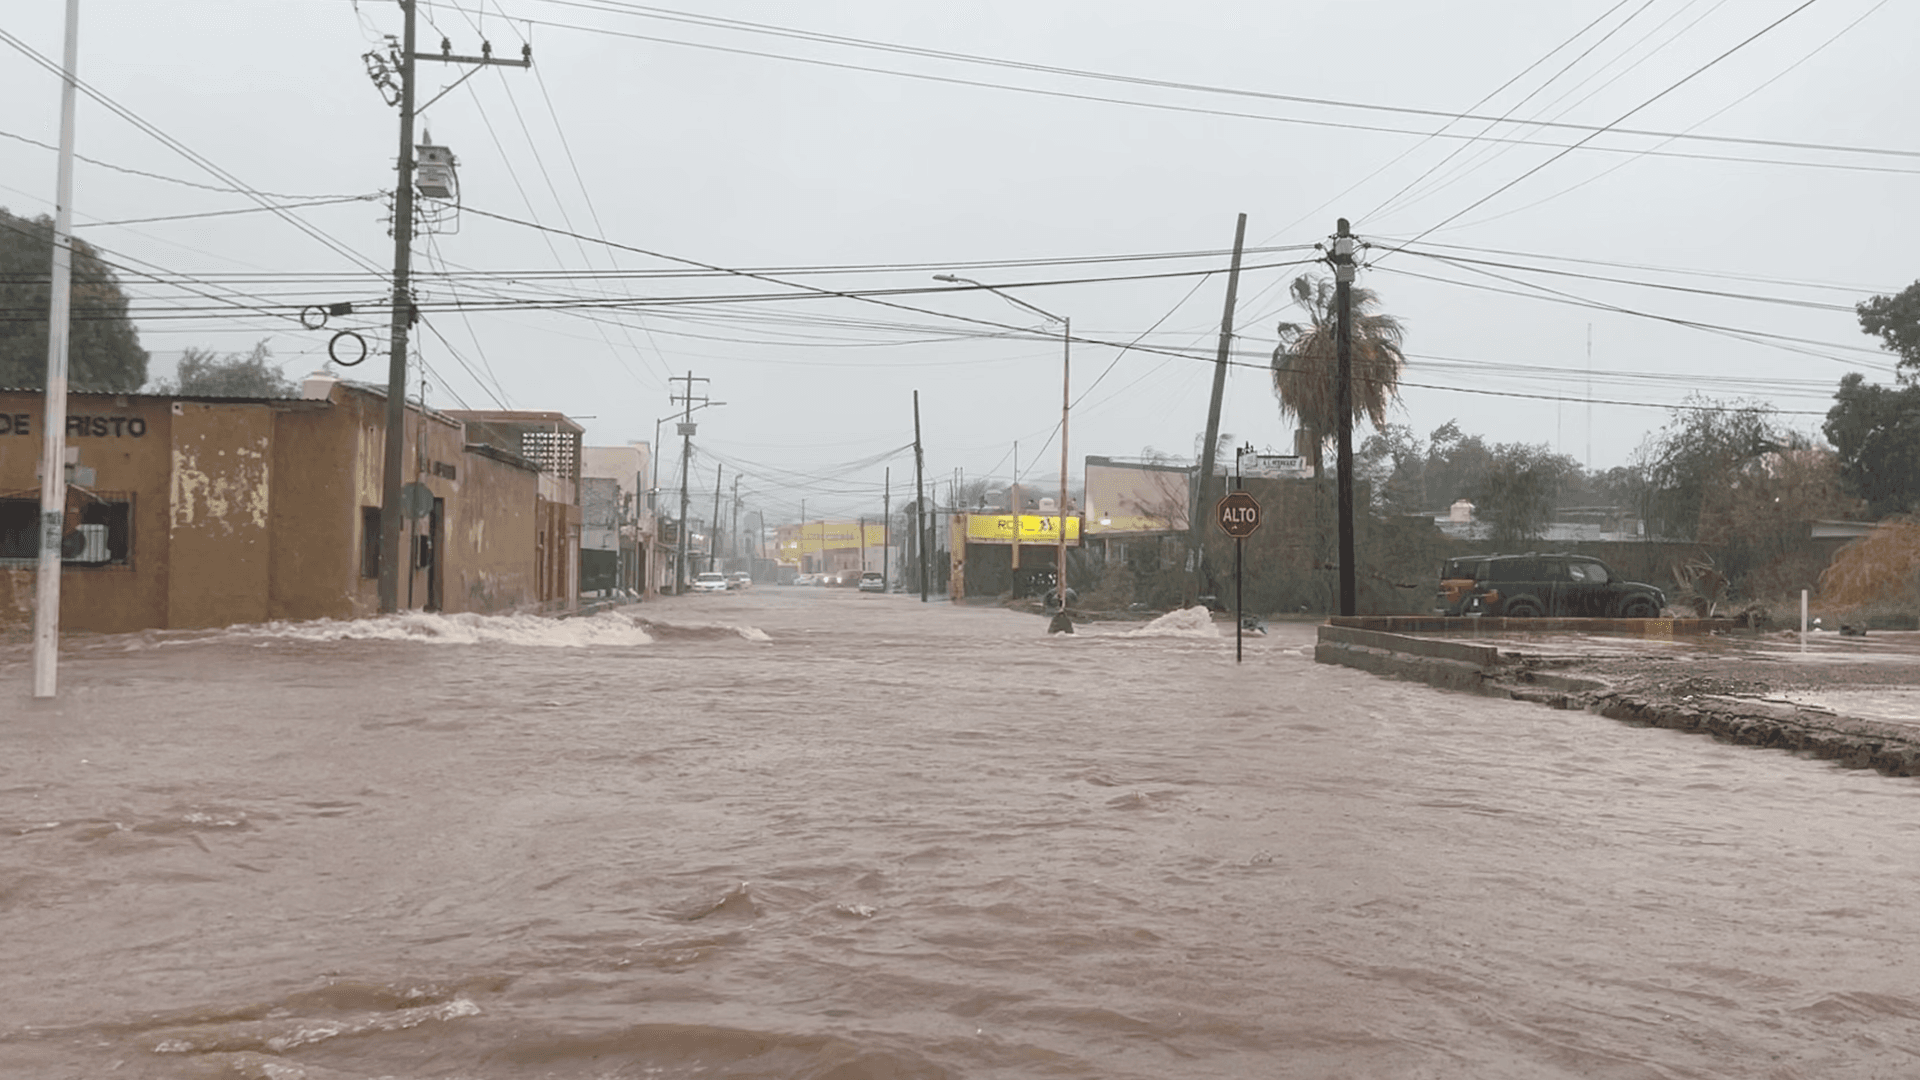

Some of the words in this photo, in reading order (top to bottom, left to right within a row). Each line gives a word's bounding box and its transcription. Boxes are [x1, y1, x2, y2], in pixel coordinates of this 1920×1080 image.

[0, 413, 30, 435] DE
[66, 415, 147, 438] RISTO
[1223, 507, 1256, 523] ALTO
